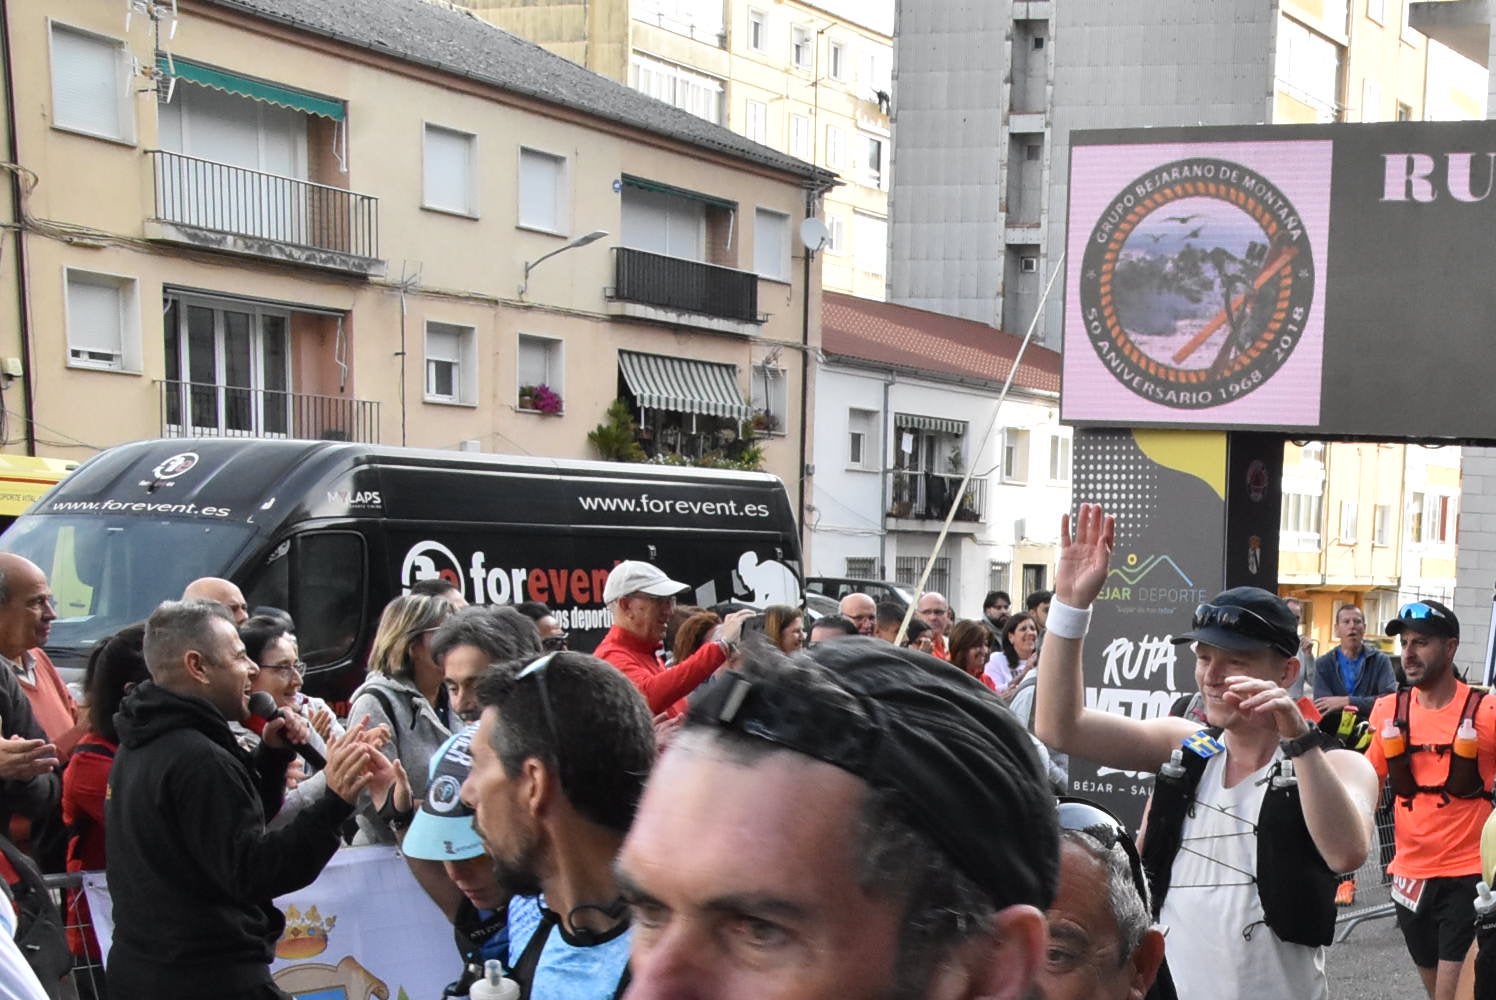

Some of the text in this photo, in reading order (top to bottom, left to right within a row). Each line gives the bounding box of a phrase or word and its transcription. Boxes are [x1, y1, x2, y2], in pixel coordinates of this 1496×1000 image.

[1096, 164, 1302, 244] GRUPO BEJARANO DE MONTAÑA
[1086, 306, 1305, 405] 50 ANIVERSARIO 1968 2018
[53, 499, 232, 518] www.forevent.es
[578, 494, 771, 518] www.forevent.es
[469, 551, 618, 605] foreven
[1138, 587, 1208, 606] DEPORTE
[1102, 634, 1178, 691] RUTA
[1073, 780, 1114, 794] BÉJAR
